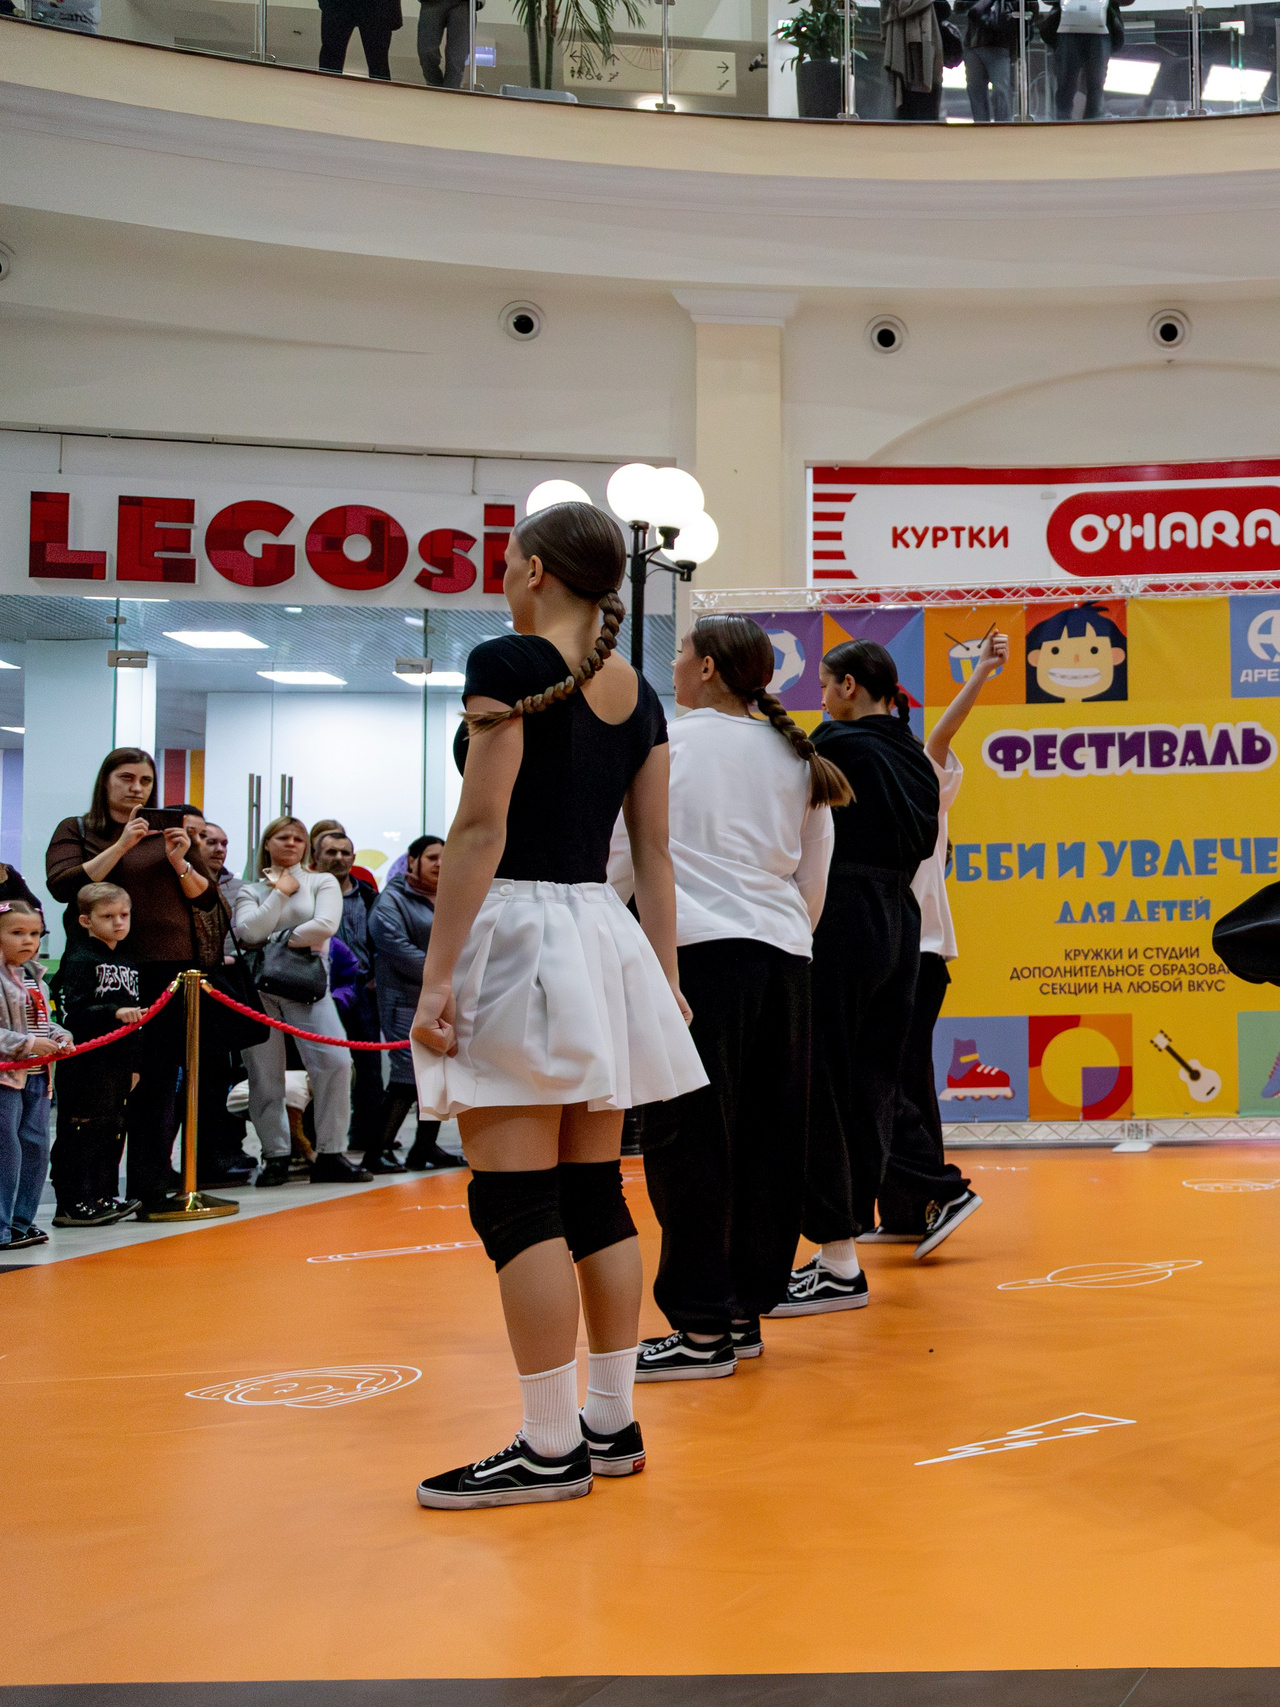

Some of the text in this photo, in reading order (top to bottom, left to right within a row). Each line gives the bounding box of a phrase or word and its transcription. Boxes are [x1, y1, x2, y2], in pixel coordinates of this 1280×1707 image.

[892, 525, 1009, 549] КУРТКИ
[987, 727, 1272, 772] ФЕСТИВАЛЬ
[1057, 842, 1086, 879] И
[1054, 896, 1211, 925] ДЛЯ ДЕТЕЙ
[1064, 946, 1200, 961] КРУЖКИ И СТУДИИ
[1010, 962, 1230, 981] ДОПОЛНИТЕЛЬНОЕ ОБРАЗОВА
[1039, 977, 1226, 996] СЕКЦИИ НА ЛЮБОЙ ВКУС
